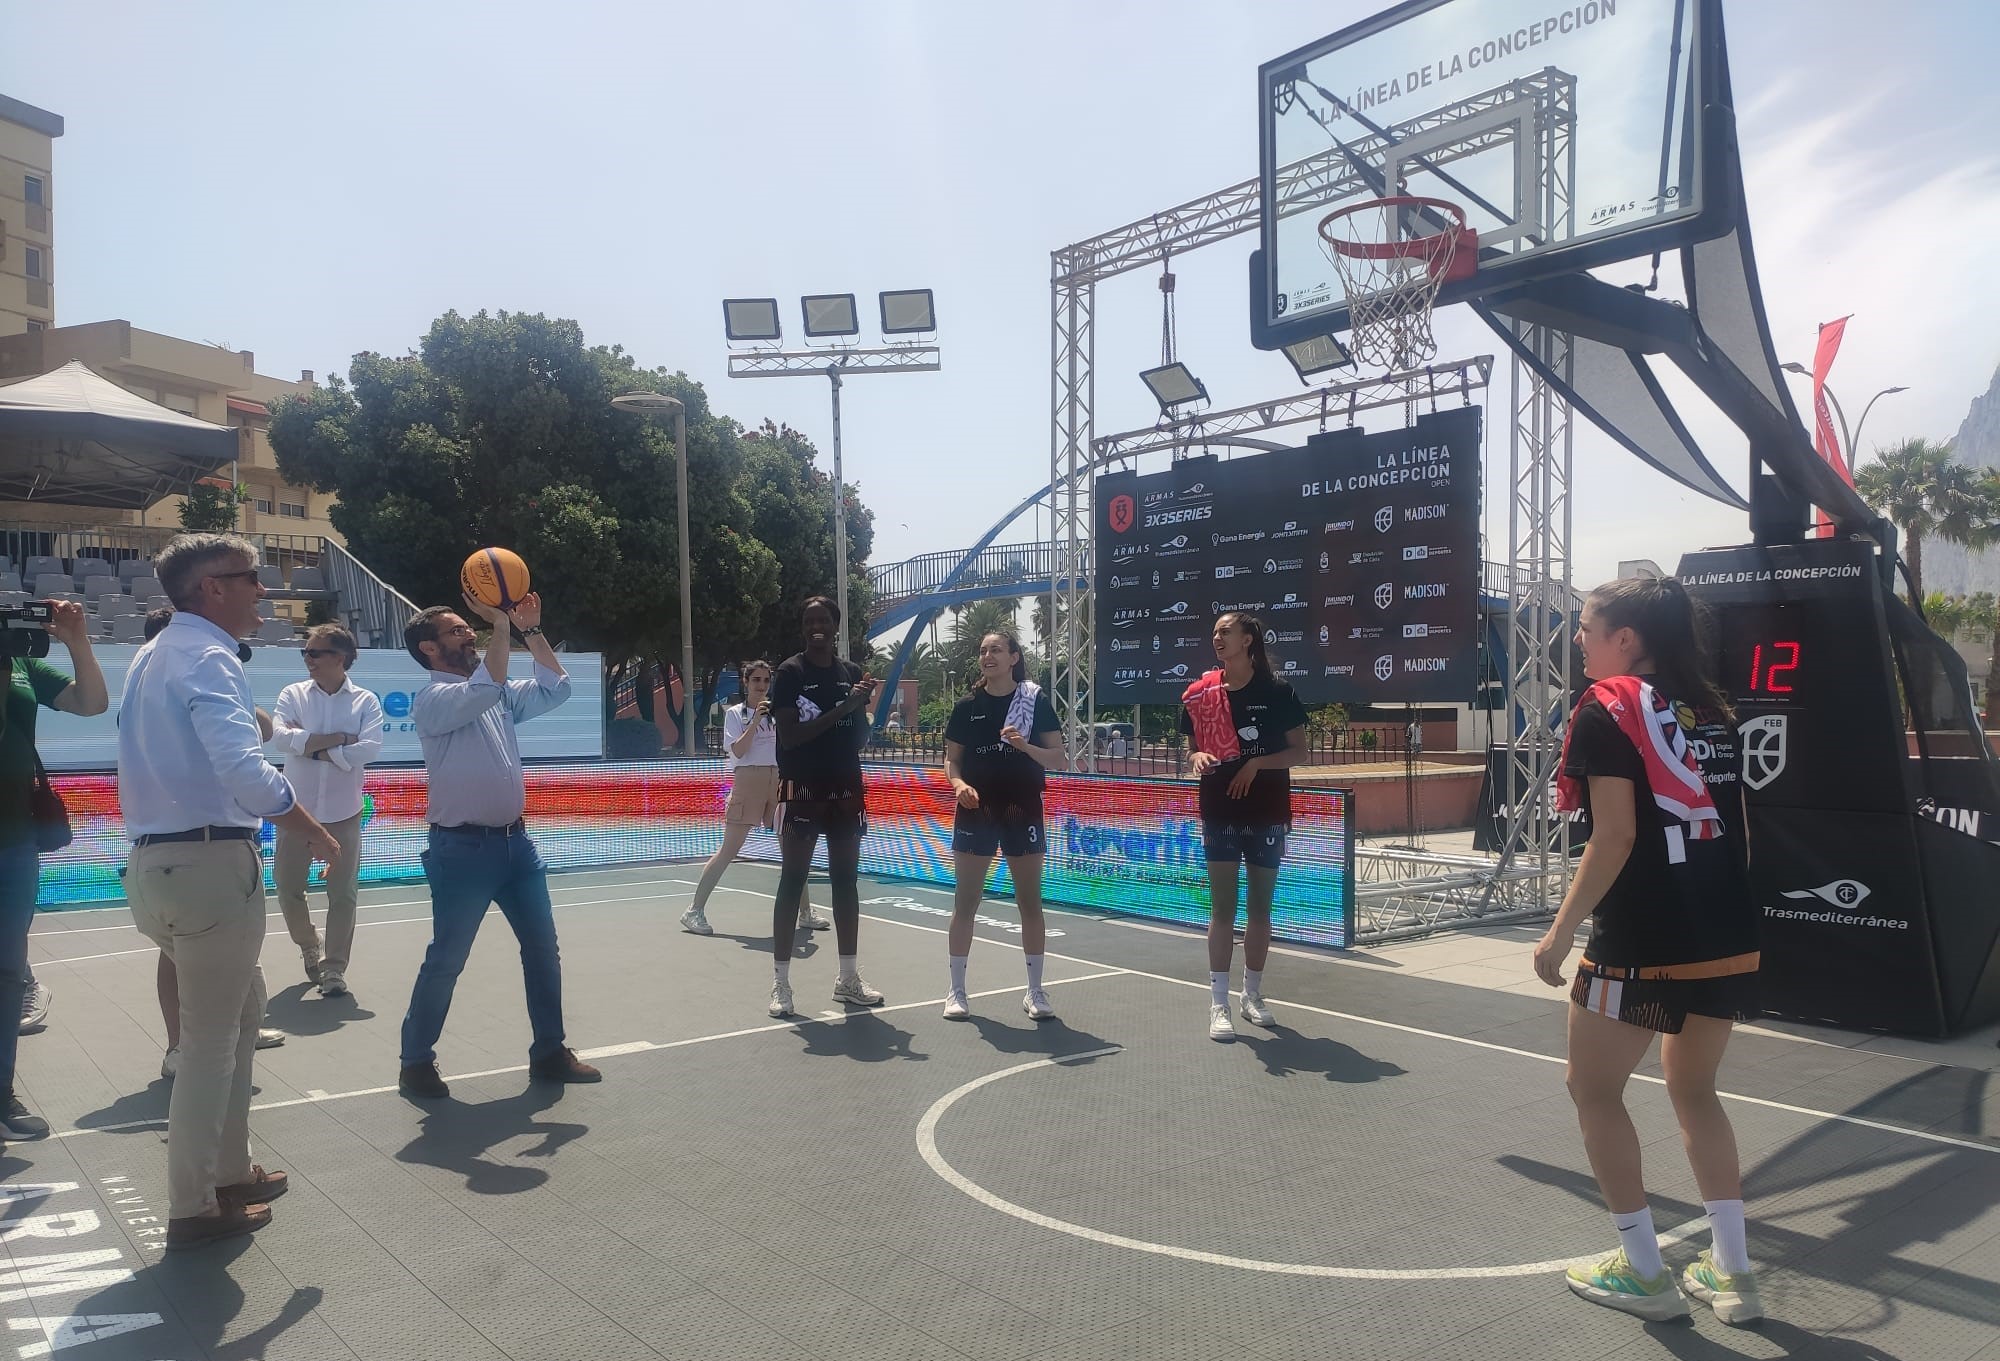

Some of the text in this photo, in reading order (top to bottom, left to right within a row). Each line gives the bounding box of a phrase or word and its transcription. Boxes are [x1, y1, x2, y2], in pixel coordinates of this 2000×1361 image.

[1320, 0, 1616, 126] LA LÍNEA DE LA CONCEPCIÓN
[1591, 201, 1635, 220] ARMAS
[1377, 445, 1451, 469] LA LÍNEA
[1302, 462, 1450, 497] DE LA CONCEPCIÓN
[1431, 479, 1451, 488] OPEN
[1144, 491, 1175, 503] ARMAS
[1144, 506, 1213, 528] 3X3SERIES
[1219, 534, 1238, 543] Gana
[1113, 544, 1150, 557] ARMAS
[1682, 564, 1861, 586] LA LÍNEA DE LA CONCEPCIÓN
[1113, 608, 1150, 619] ARMAS
[1219, 602, 1238, 611] Gana
[1113, 669, 1150, 679] ARMAS
[1750, 642, 1800, 692] 12
[1764, 719, 1783, 728] FEB
[1028, 825, 1038, 843] 3
[1762, 906, 1909, 930] Trasmediterránea
[100, 1175, 167, 1251] NAVIERA
